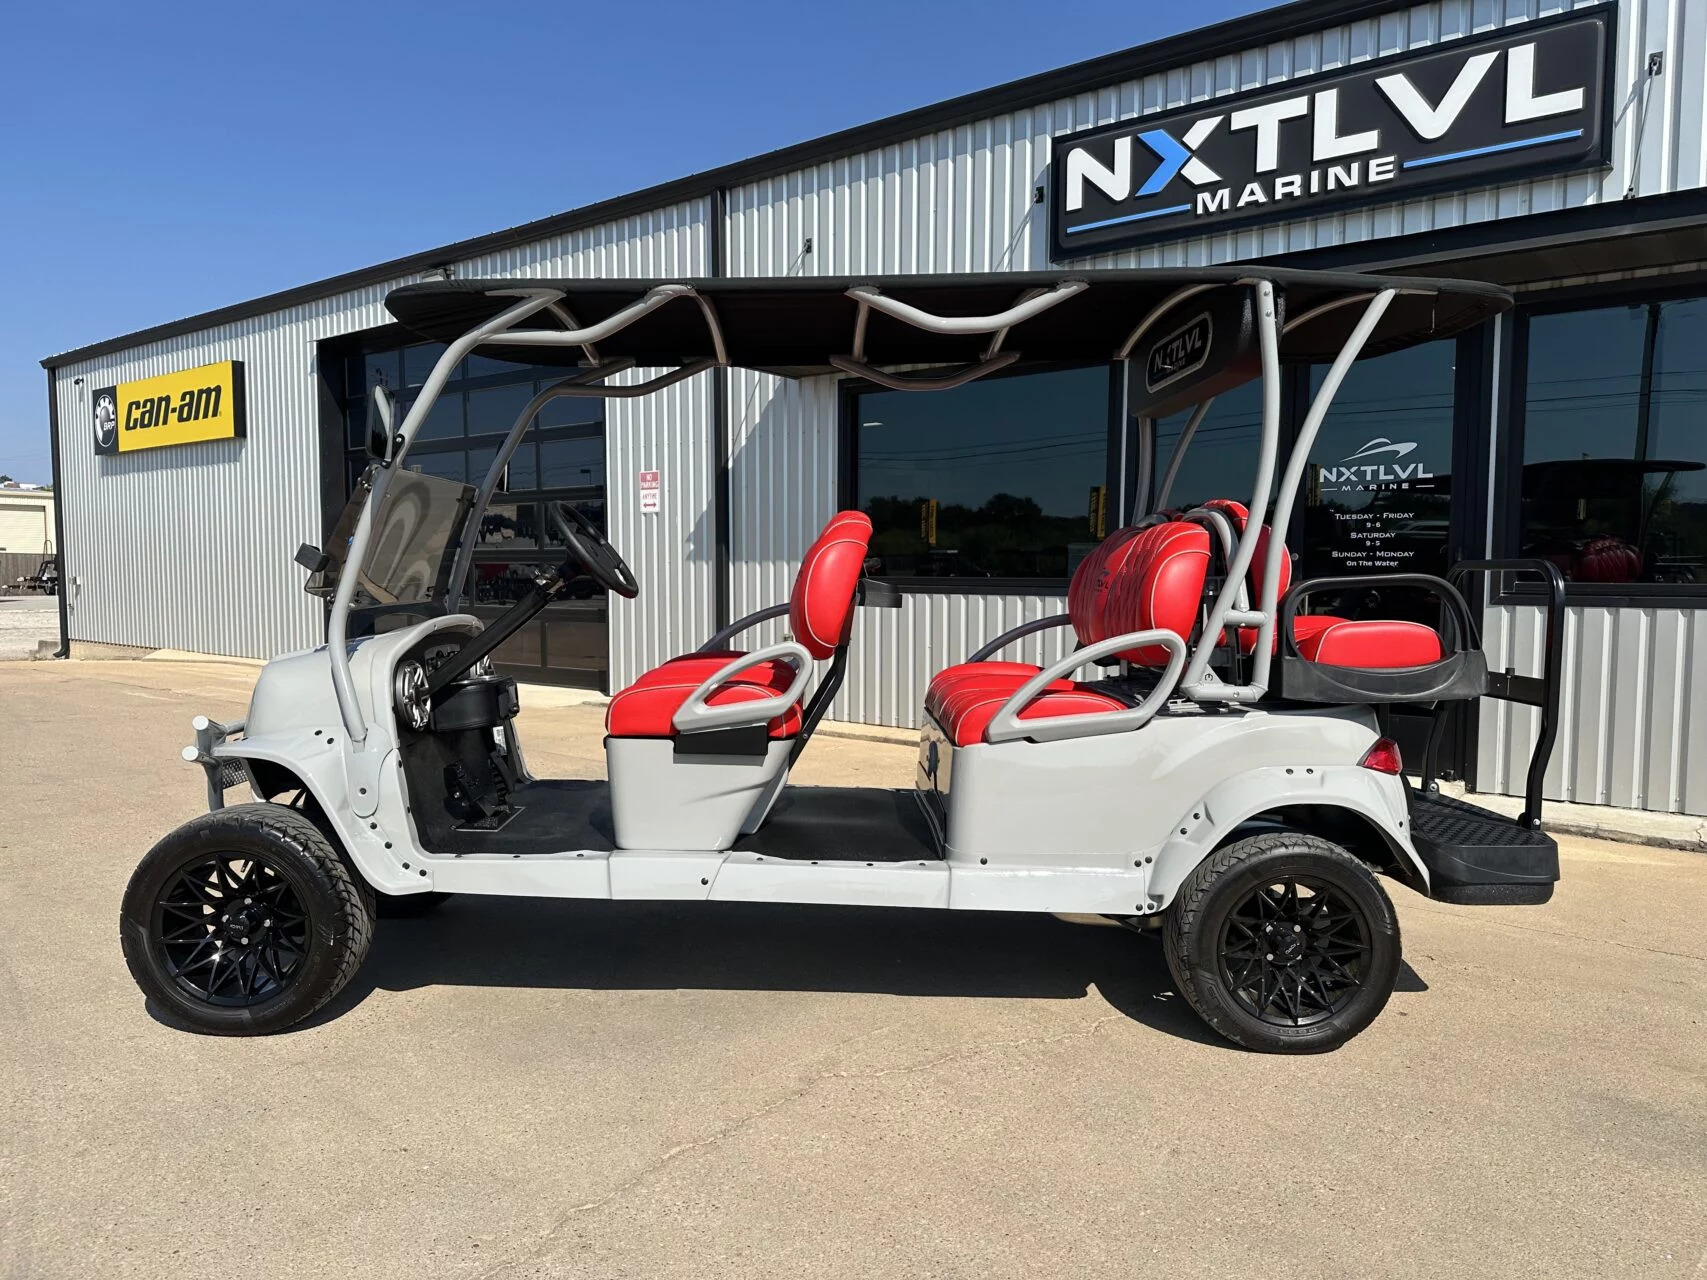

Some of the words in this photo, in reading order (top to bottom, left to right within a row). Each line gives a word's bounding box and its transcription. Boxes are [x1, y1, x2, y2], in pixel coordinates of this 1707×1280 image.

[1066, 43, 1584, 212] NXTLVL
[1196, 155, 1397, 215] MARINE
[125, 384, 222, 432] can-am
[103, 420, 115, 431] BRP
[1319, 463, 1434, 483] NXTLVL
[1341, 483, 1410, 491] MARINE
